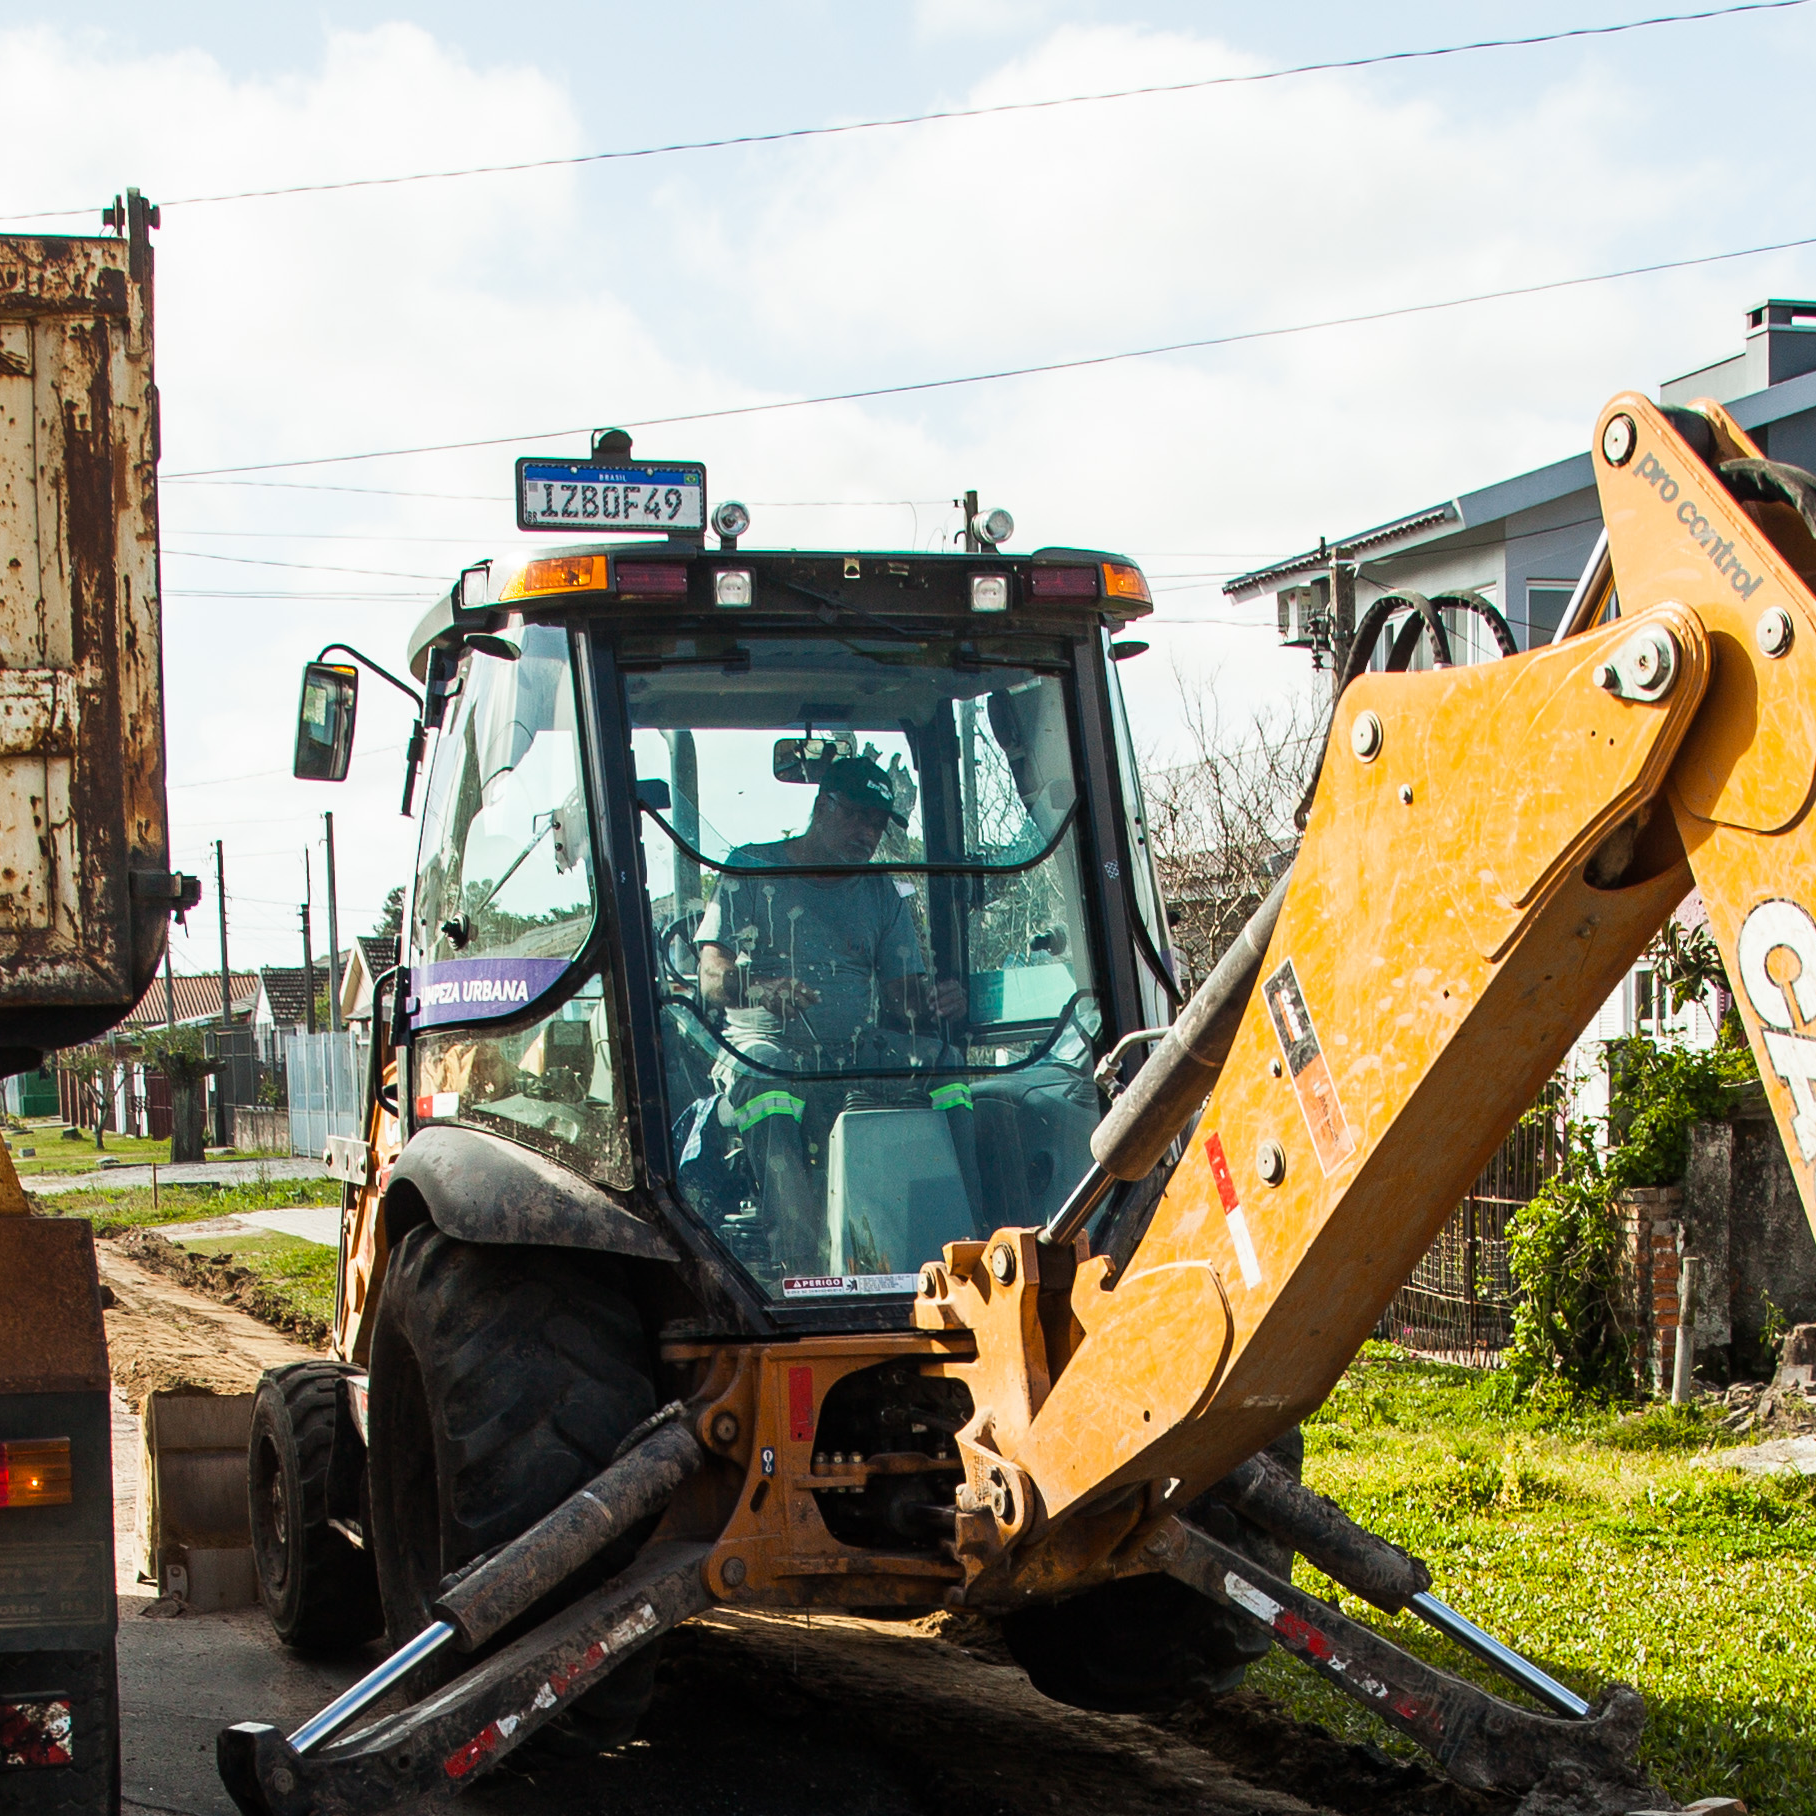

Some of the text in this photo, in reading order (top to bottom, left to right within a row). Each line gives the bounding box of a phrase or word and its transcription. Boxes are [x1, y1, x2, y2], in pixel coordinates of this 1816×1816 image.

[598, 473, 628, 482] BRASIL
[1633, 451, 1764, 602] pro control
[420, 979, 529, 1007] LIMPEZA URBANA
[802, 1278, 841, 1287] PERIGO
